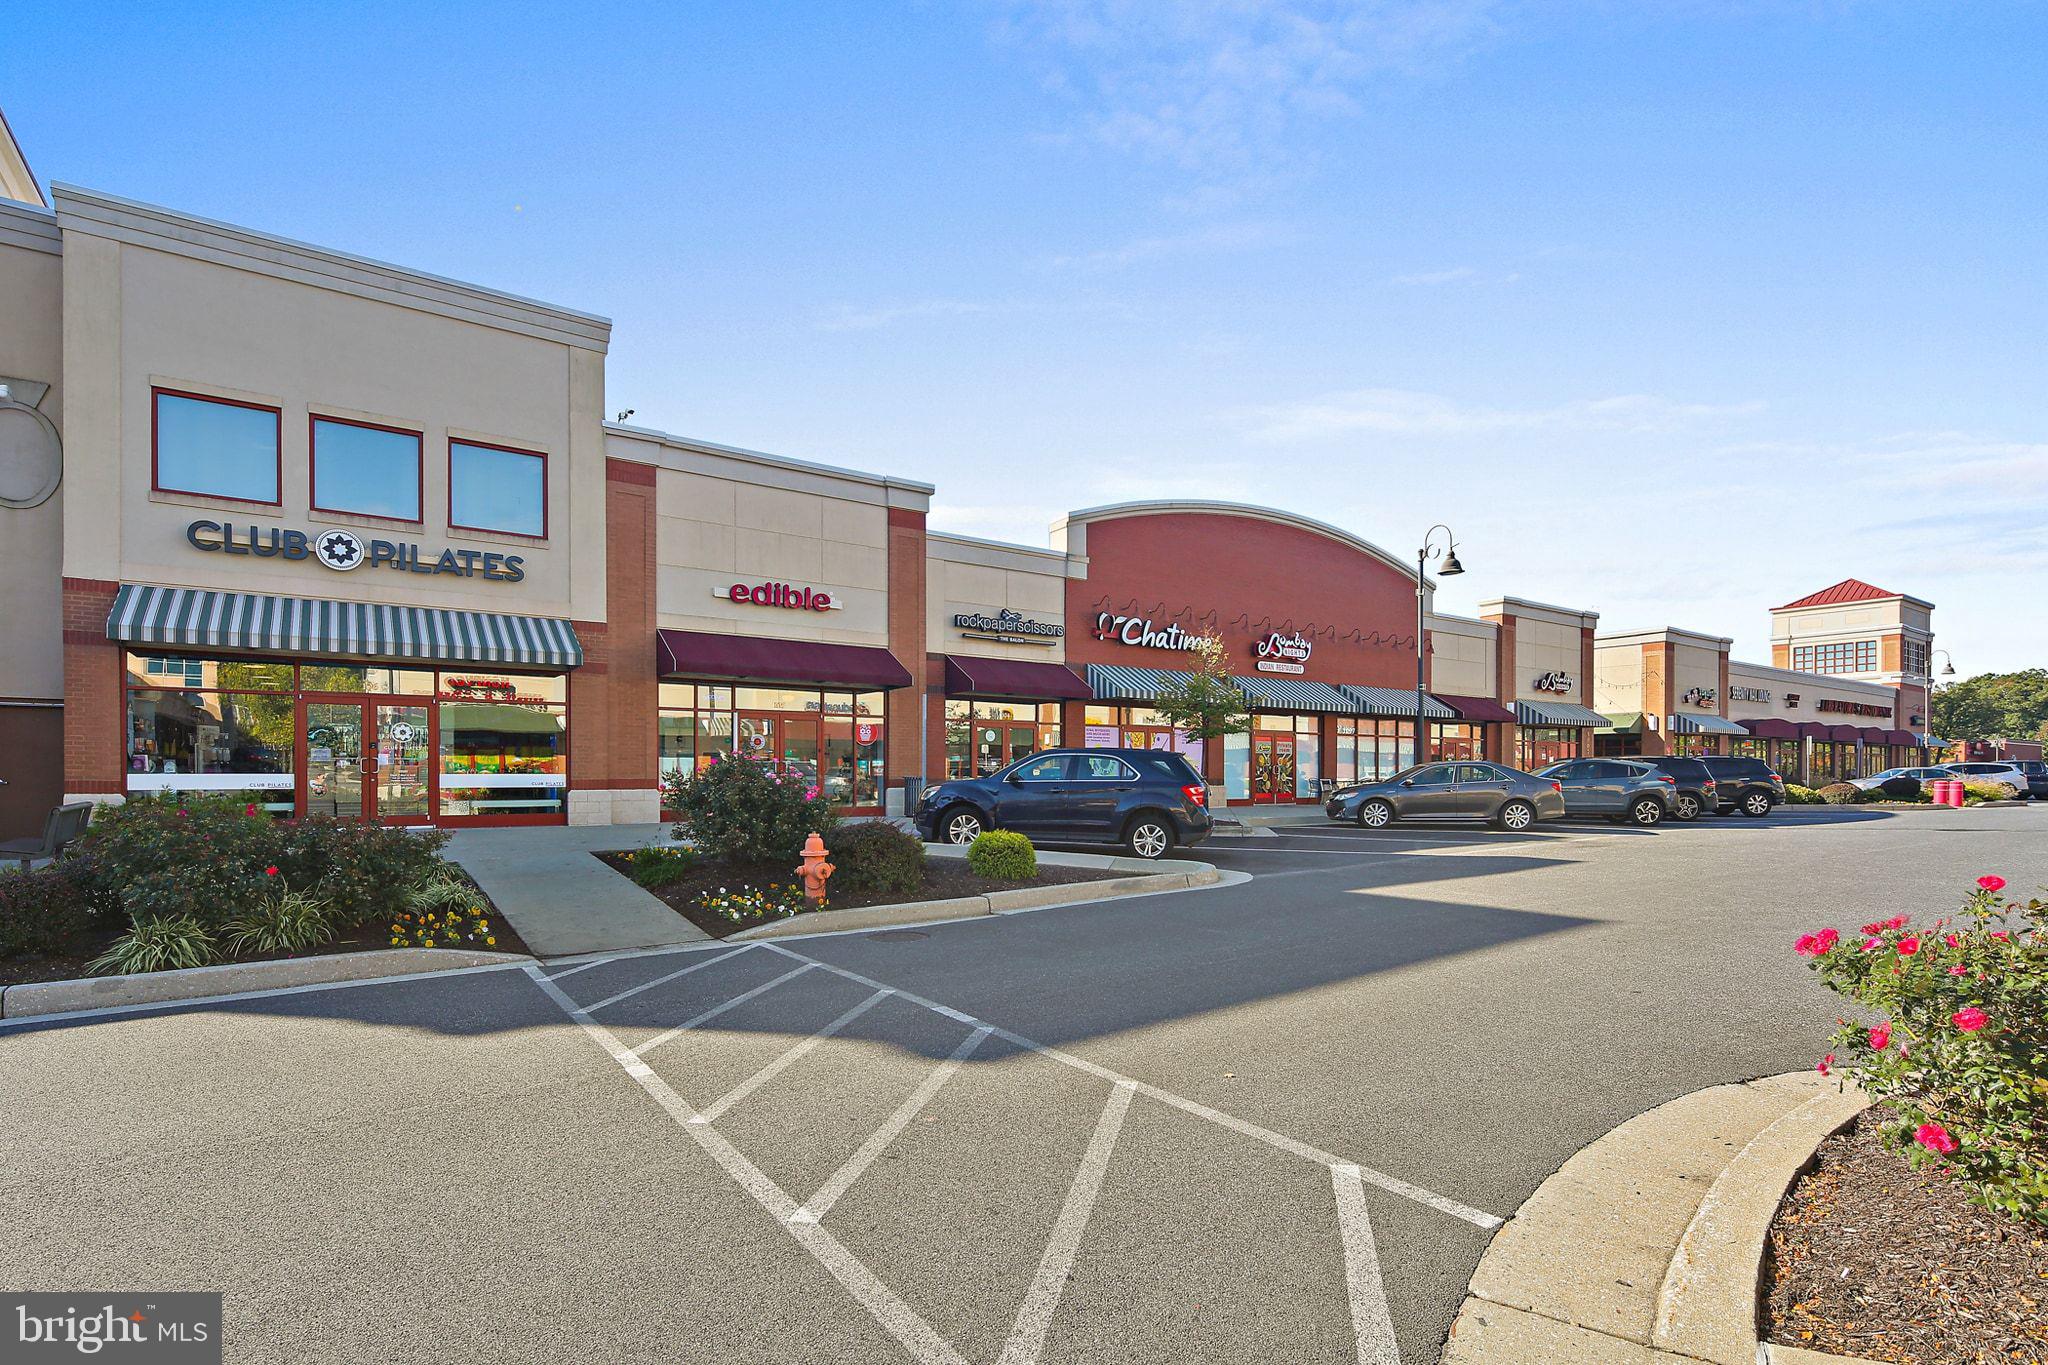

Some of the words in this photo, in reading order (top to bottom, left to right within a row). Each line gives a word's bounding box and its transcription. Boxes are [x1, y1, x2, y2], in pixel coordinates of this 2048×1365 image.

[187, 520, 310, 561] CLUB
[371, 540, 525, 582] PILATES
[730, 582, 831, 612] edible
[956, 614, 1064, 636] rockpaperscissors
[1258, 632, 1311, 661] Bombay
[1260, 662, 1274, 670] INDIAN
[1276, 663, 1302, 673] RESTAURANT
